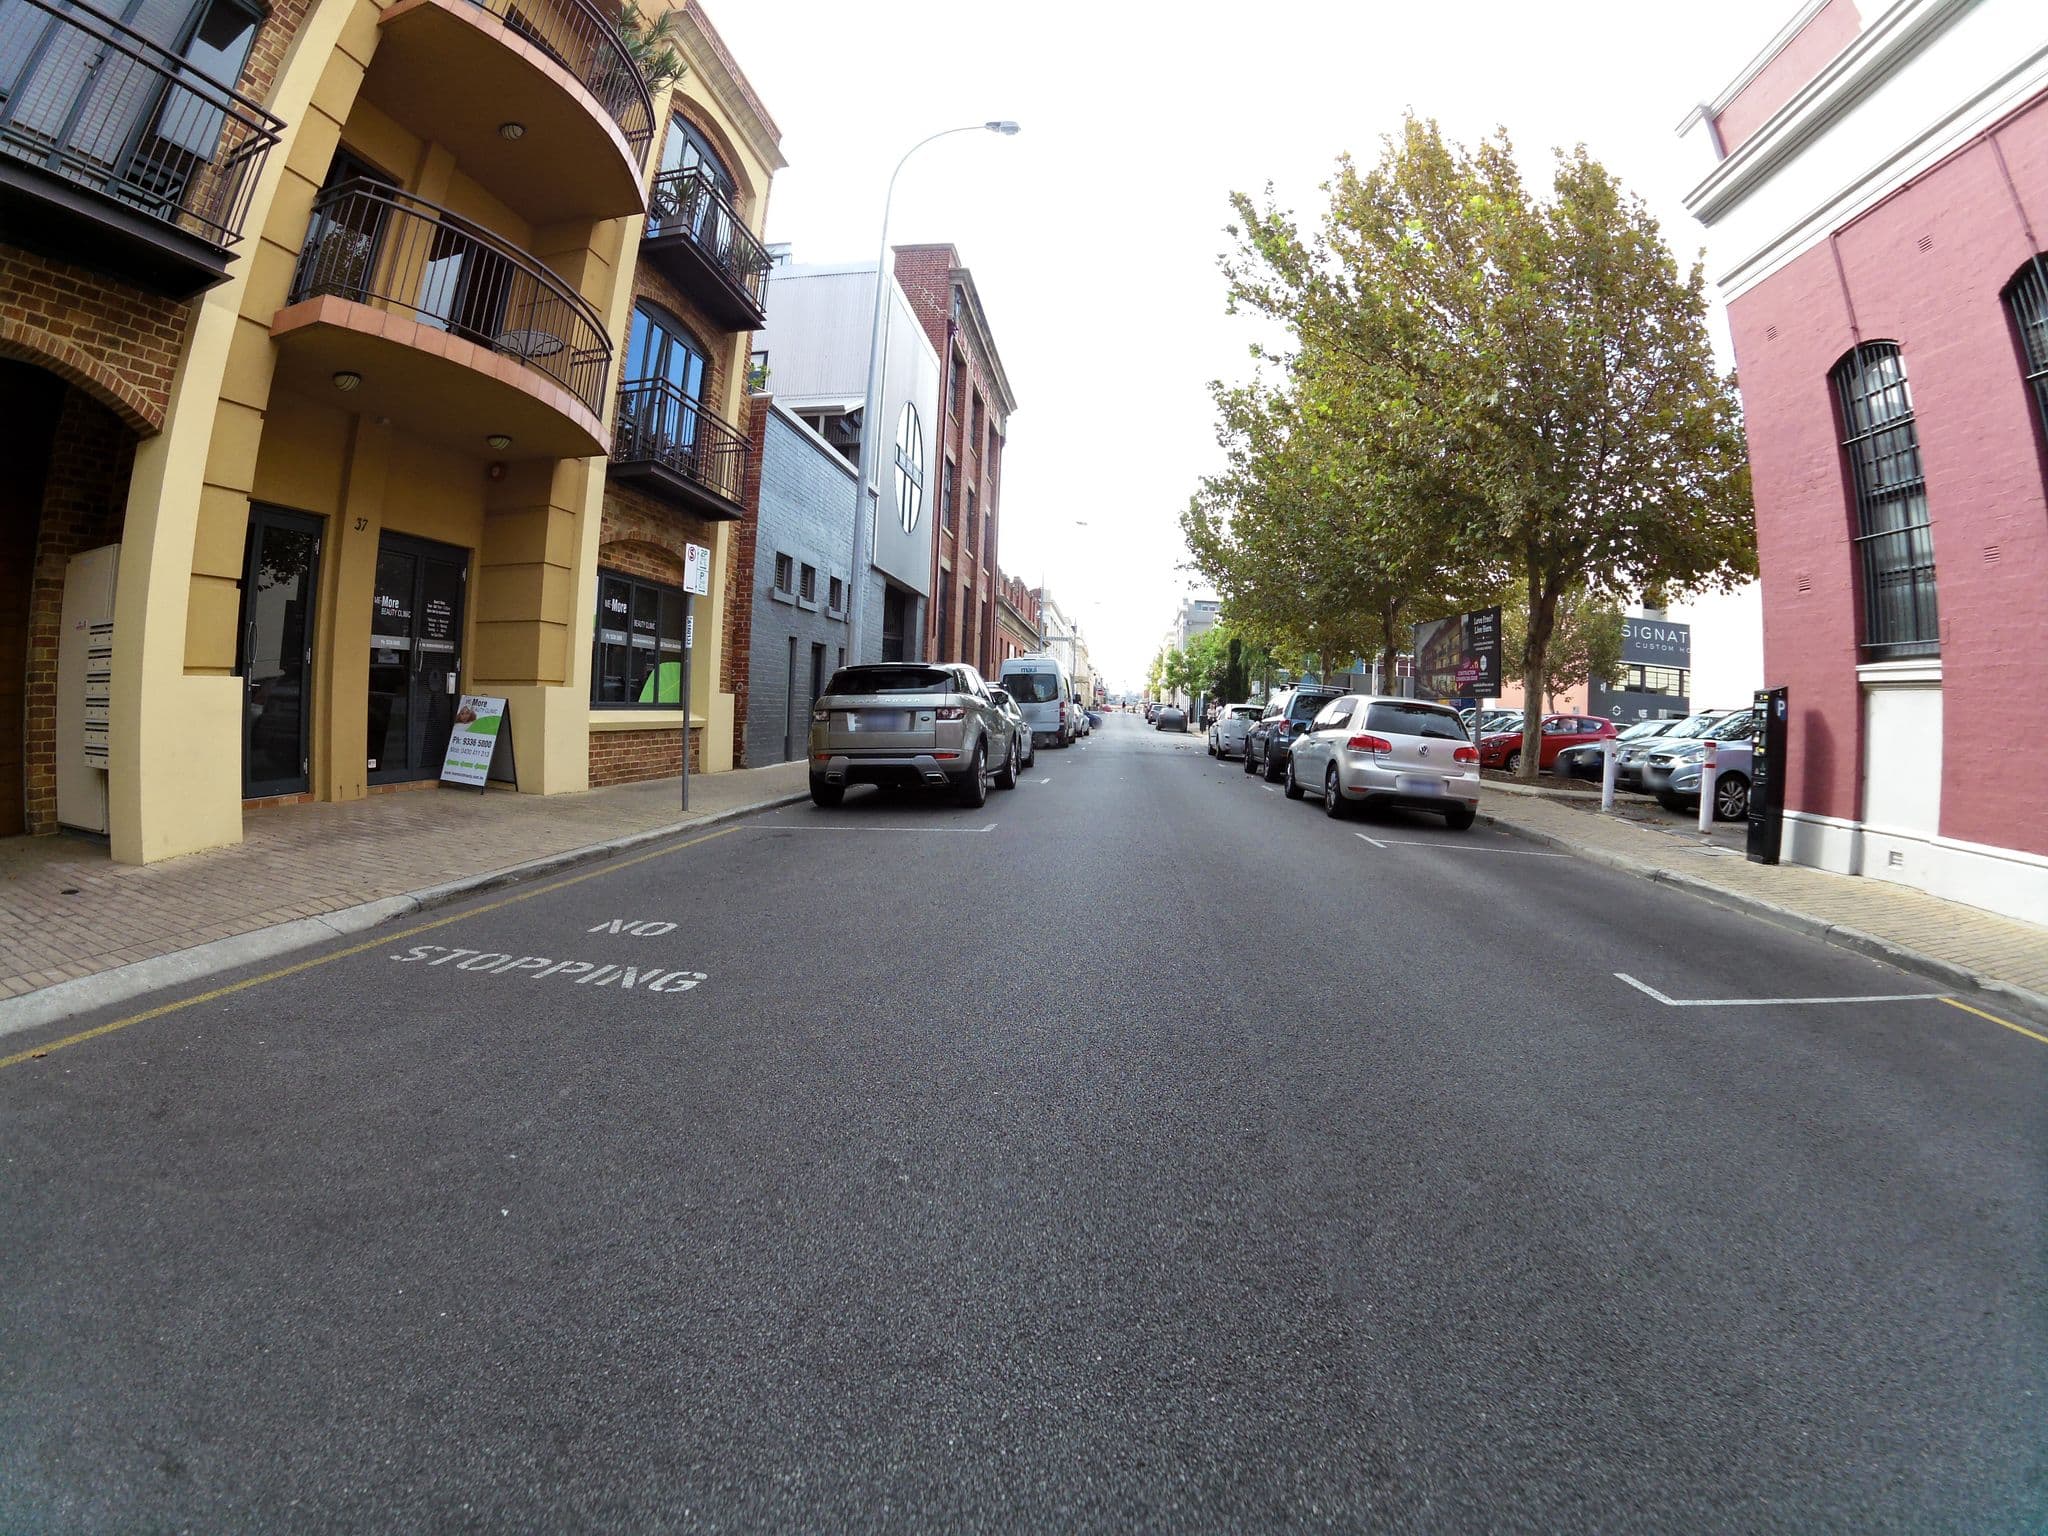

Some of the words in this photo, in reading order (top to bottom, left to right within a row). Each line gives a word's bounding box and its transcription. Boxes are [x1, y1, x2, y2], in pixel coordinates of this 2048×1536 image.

[354, 517, 368, 531] 37
[381, 595, 400, 608] More
[611, 598, 627, 613] More
[381, 607, 397, 616] BEAUTY
[398, 609, 411, 618] CLINIC
[1621, 624, 1688, 643] SIGNAT
[1636, 642, 1674, 652] CUSTOM
[471, 698, 488, 708] More
[1777, 700, 1786, 716] P
[587, 919, 678, 937] NO
[390, 945, 708, 992] STOPPING
